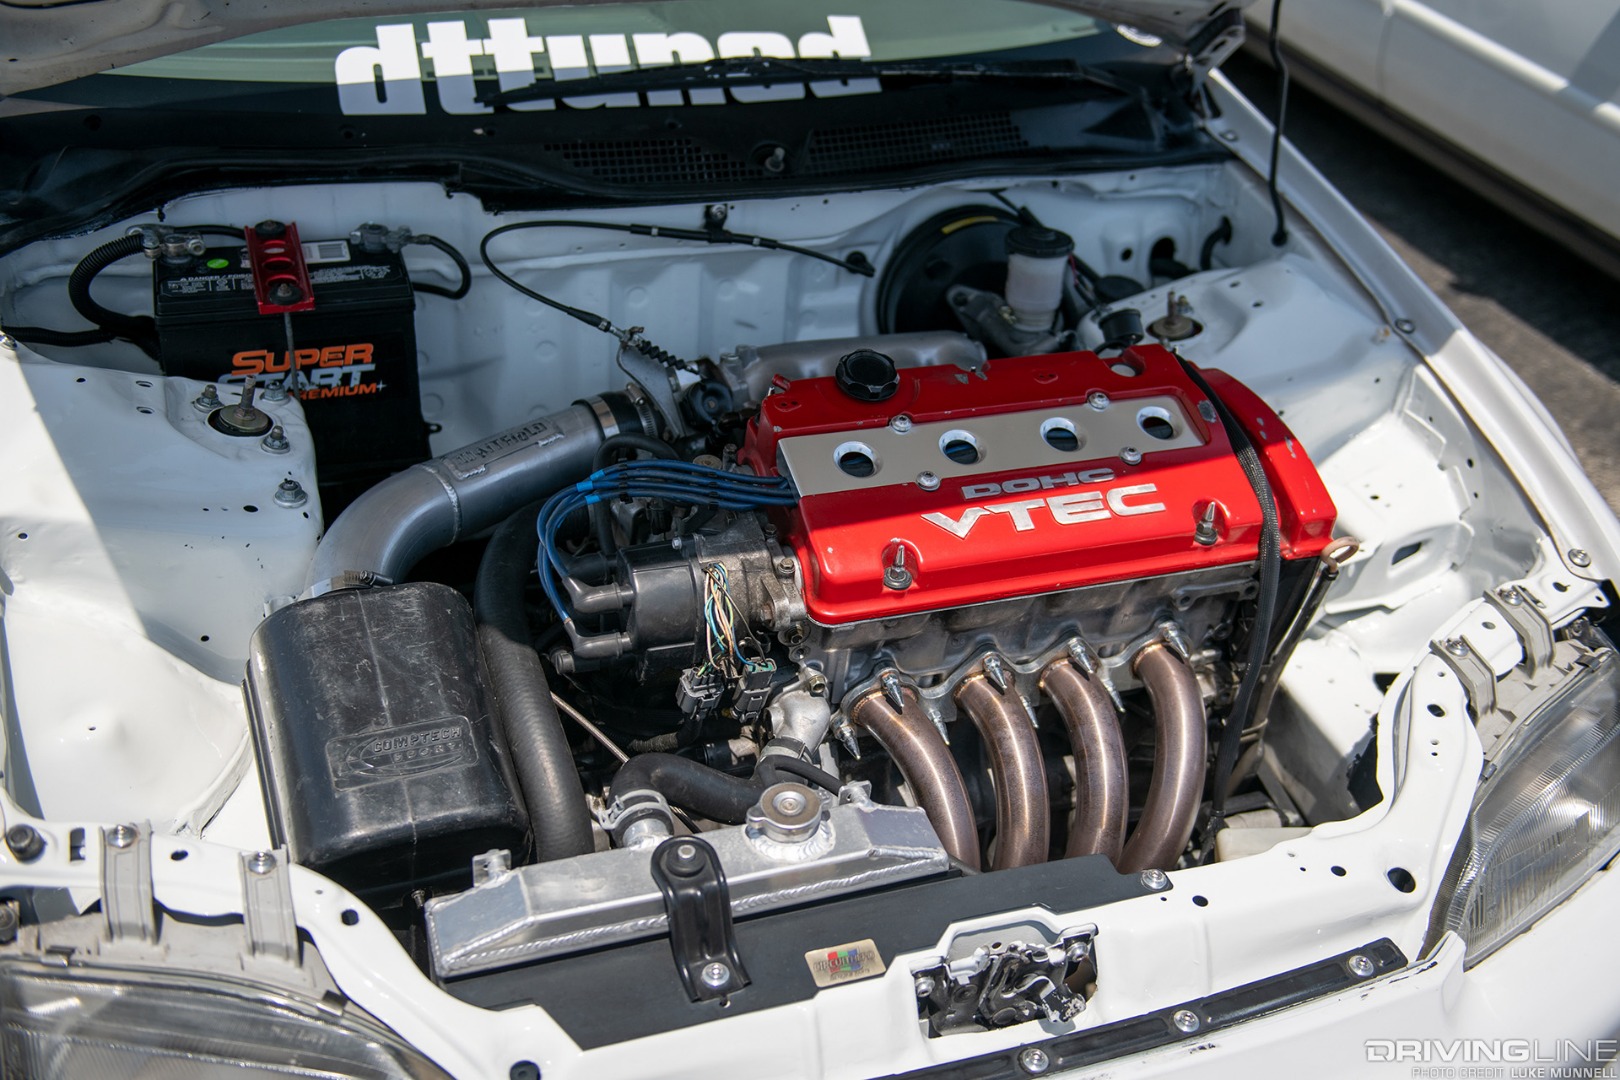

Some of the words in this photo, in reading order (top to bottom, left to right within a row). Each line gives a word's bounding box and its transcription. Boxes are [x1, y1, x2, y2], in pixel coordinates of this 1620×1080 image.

[335, 16, 881, 115] dttuned
[231, 343, 374, 377] SUPER
[961, 467, 1115, 500] DOHC
[920, 483, 1166, 540] VTEC
[373, 726, 462, 754] COMPTECH
